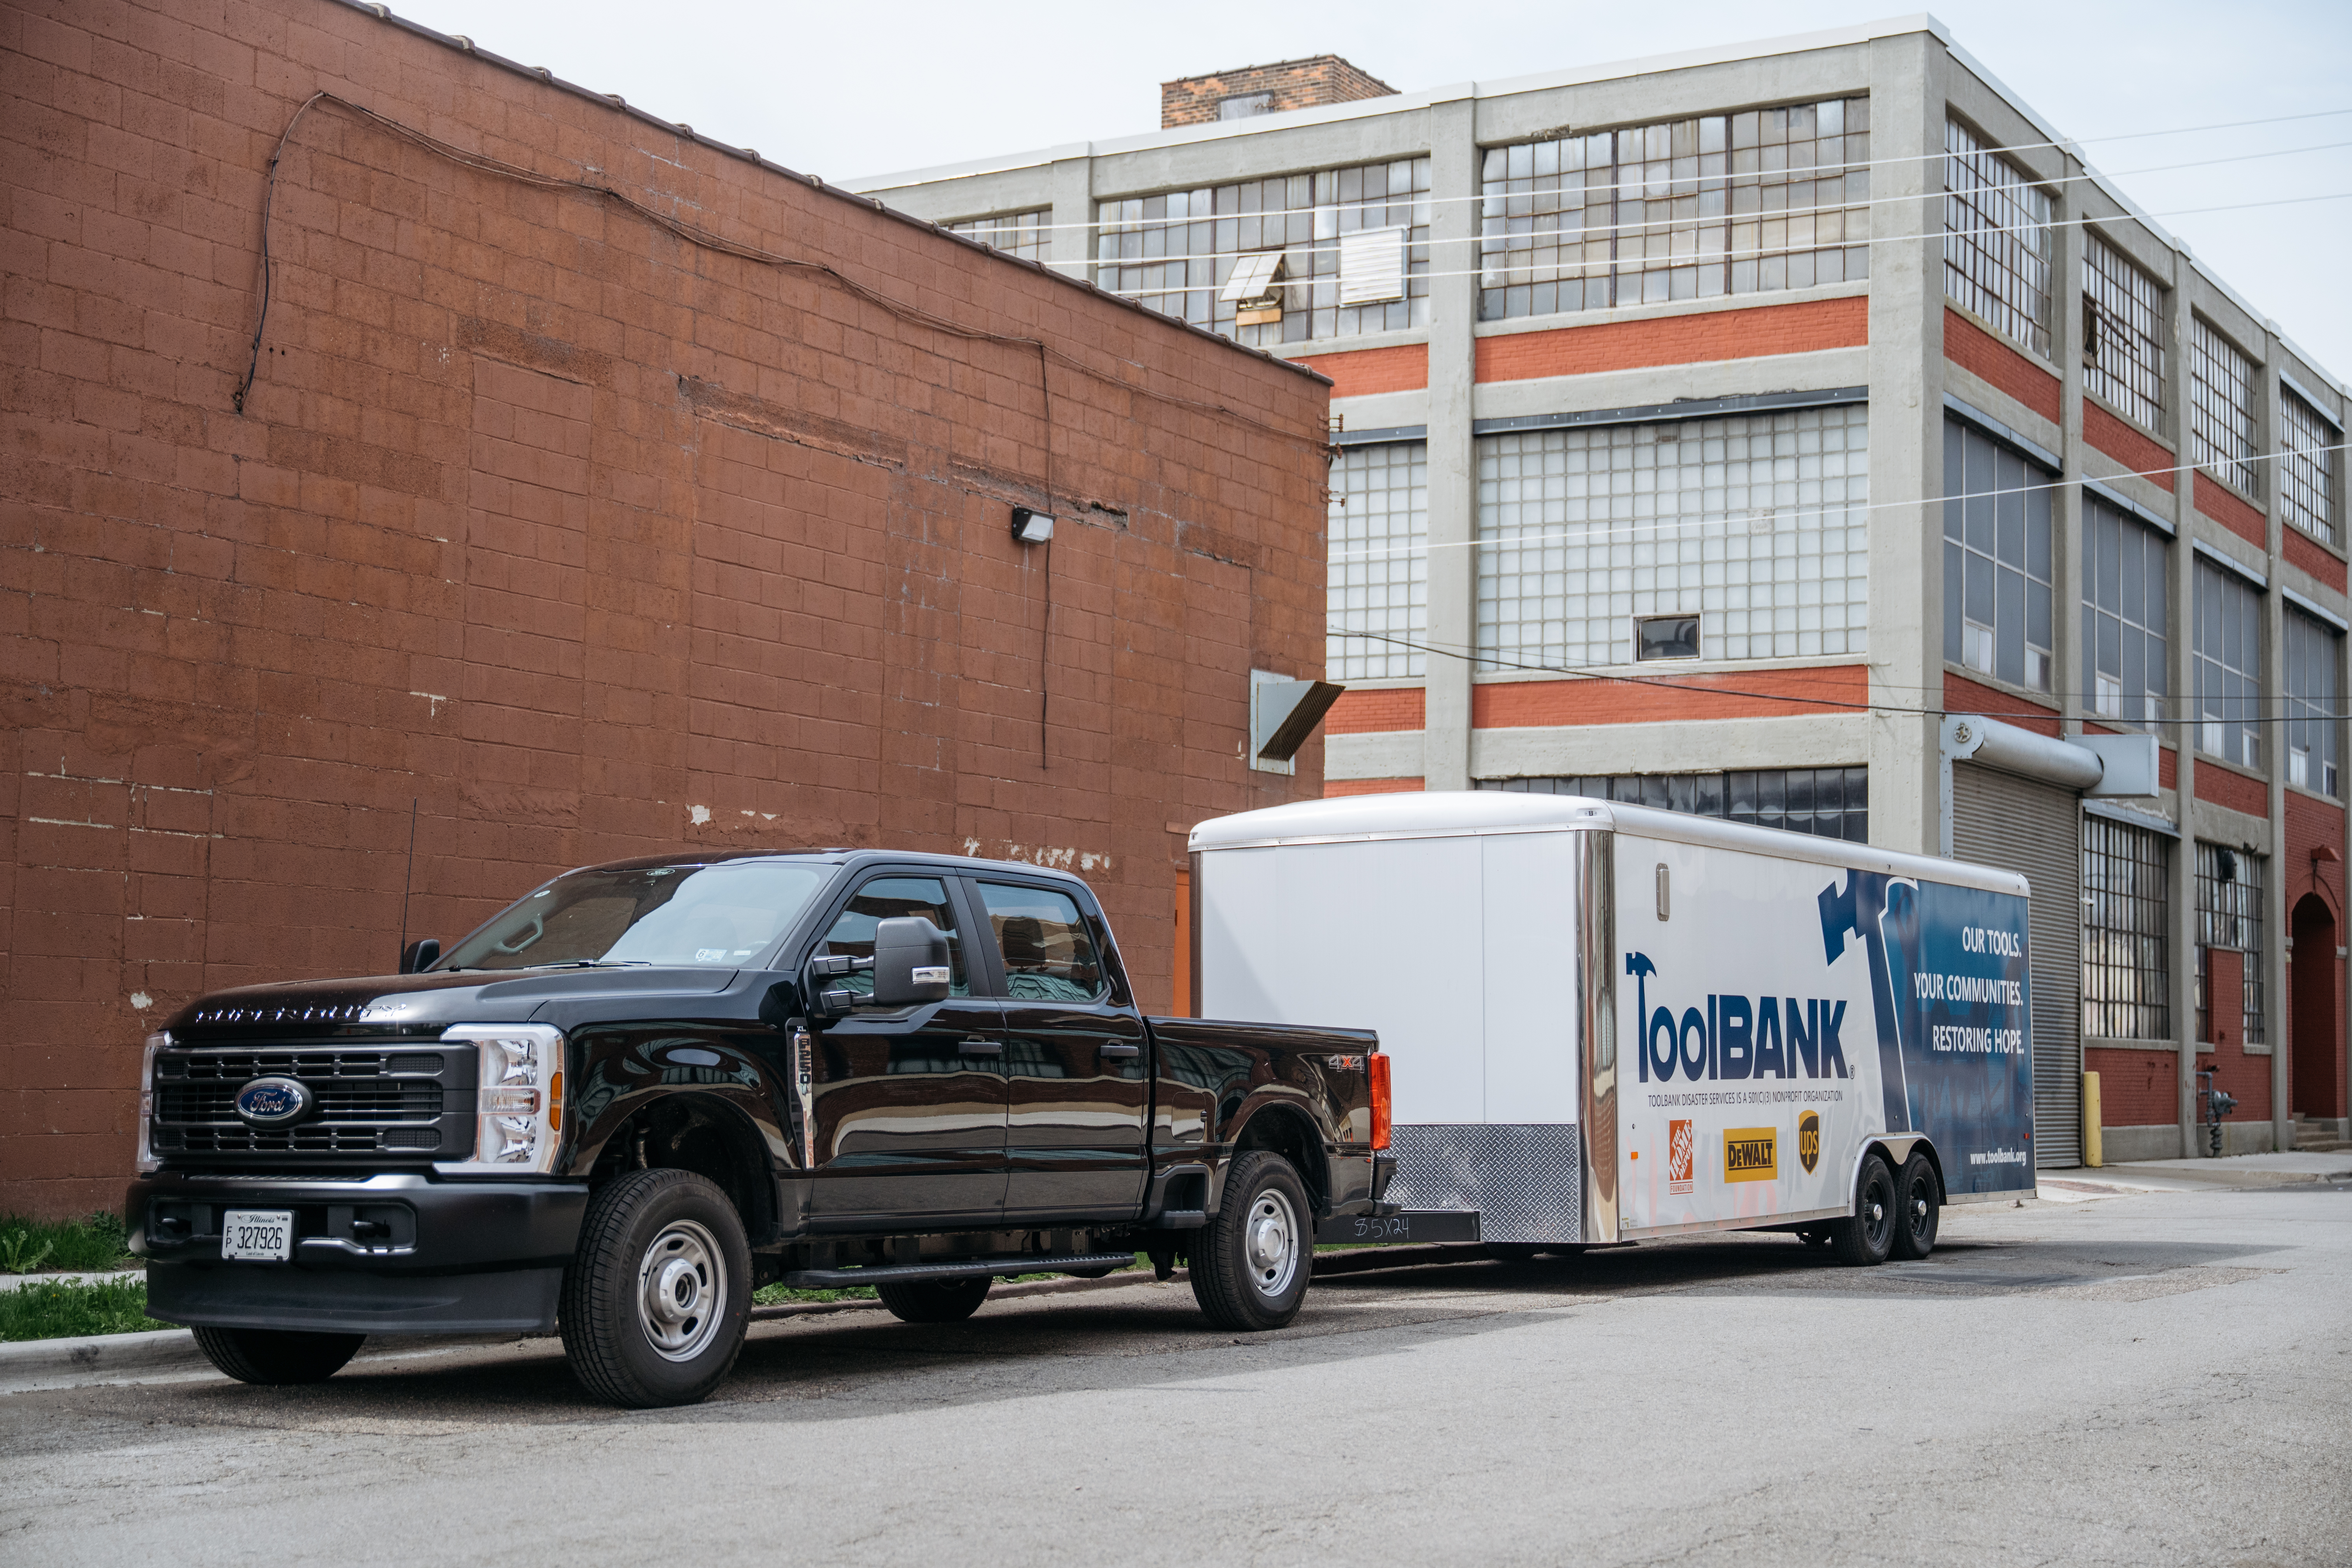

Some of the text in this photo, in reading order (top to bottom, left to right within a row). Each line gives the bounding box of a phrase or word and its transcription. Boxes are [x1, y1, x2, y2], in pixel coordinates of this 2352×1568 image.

[1962, 926, 2021, 957] OUR TOOLS.
[1914, 973, 2023, 1006] YOUR COMMUNITIES.
[1933, 1025, 2024, 1054] RESTORING HOPE.
[799, 1038, 811, 1084] F250
[250, 1092, 286, 1111] Ford
[1648, 1090, 1843, 1107] TOOLBANK DISASTER SERVICES IS A 501(C)(3) NONPROFIT ORGANIZATION
[1671, 1126, 1682, 1150] THE
[1670, 1120, 1692, 1181] HOME
[1678, 1141, 1692, 1180] DEPOT
[1970, 1147, 2026, 1167] www.toolbank.org
[1671, 1184, 1692, 1192] FOUNDATION
[241, 1214, 275, 1223] Illinois
[237, 1226, 283, 1249] 327926
